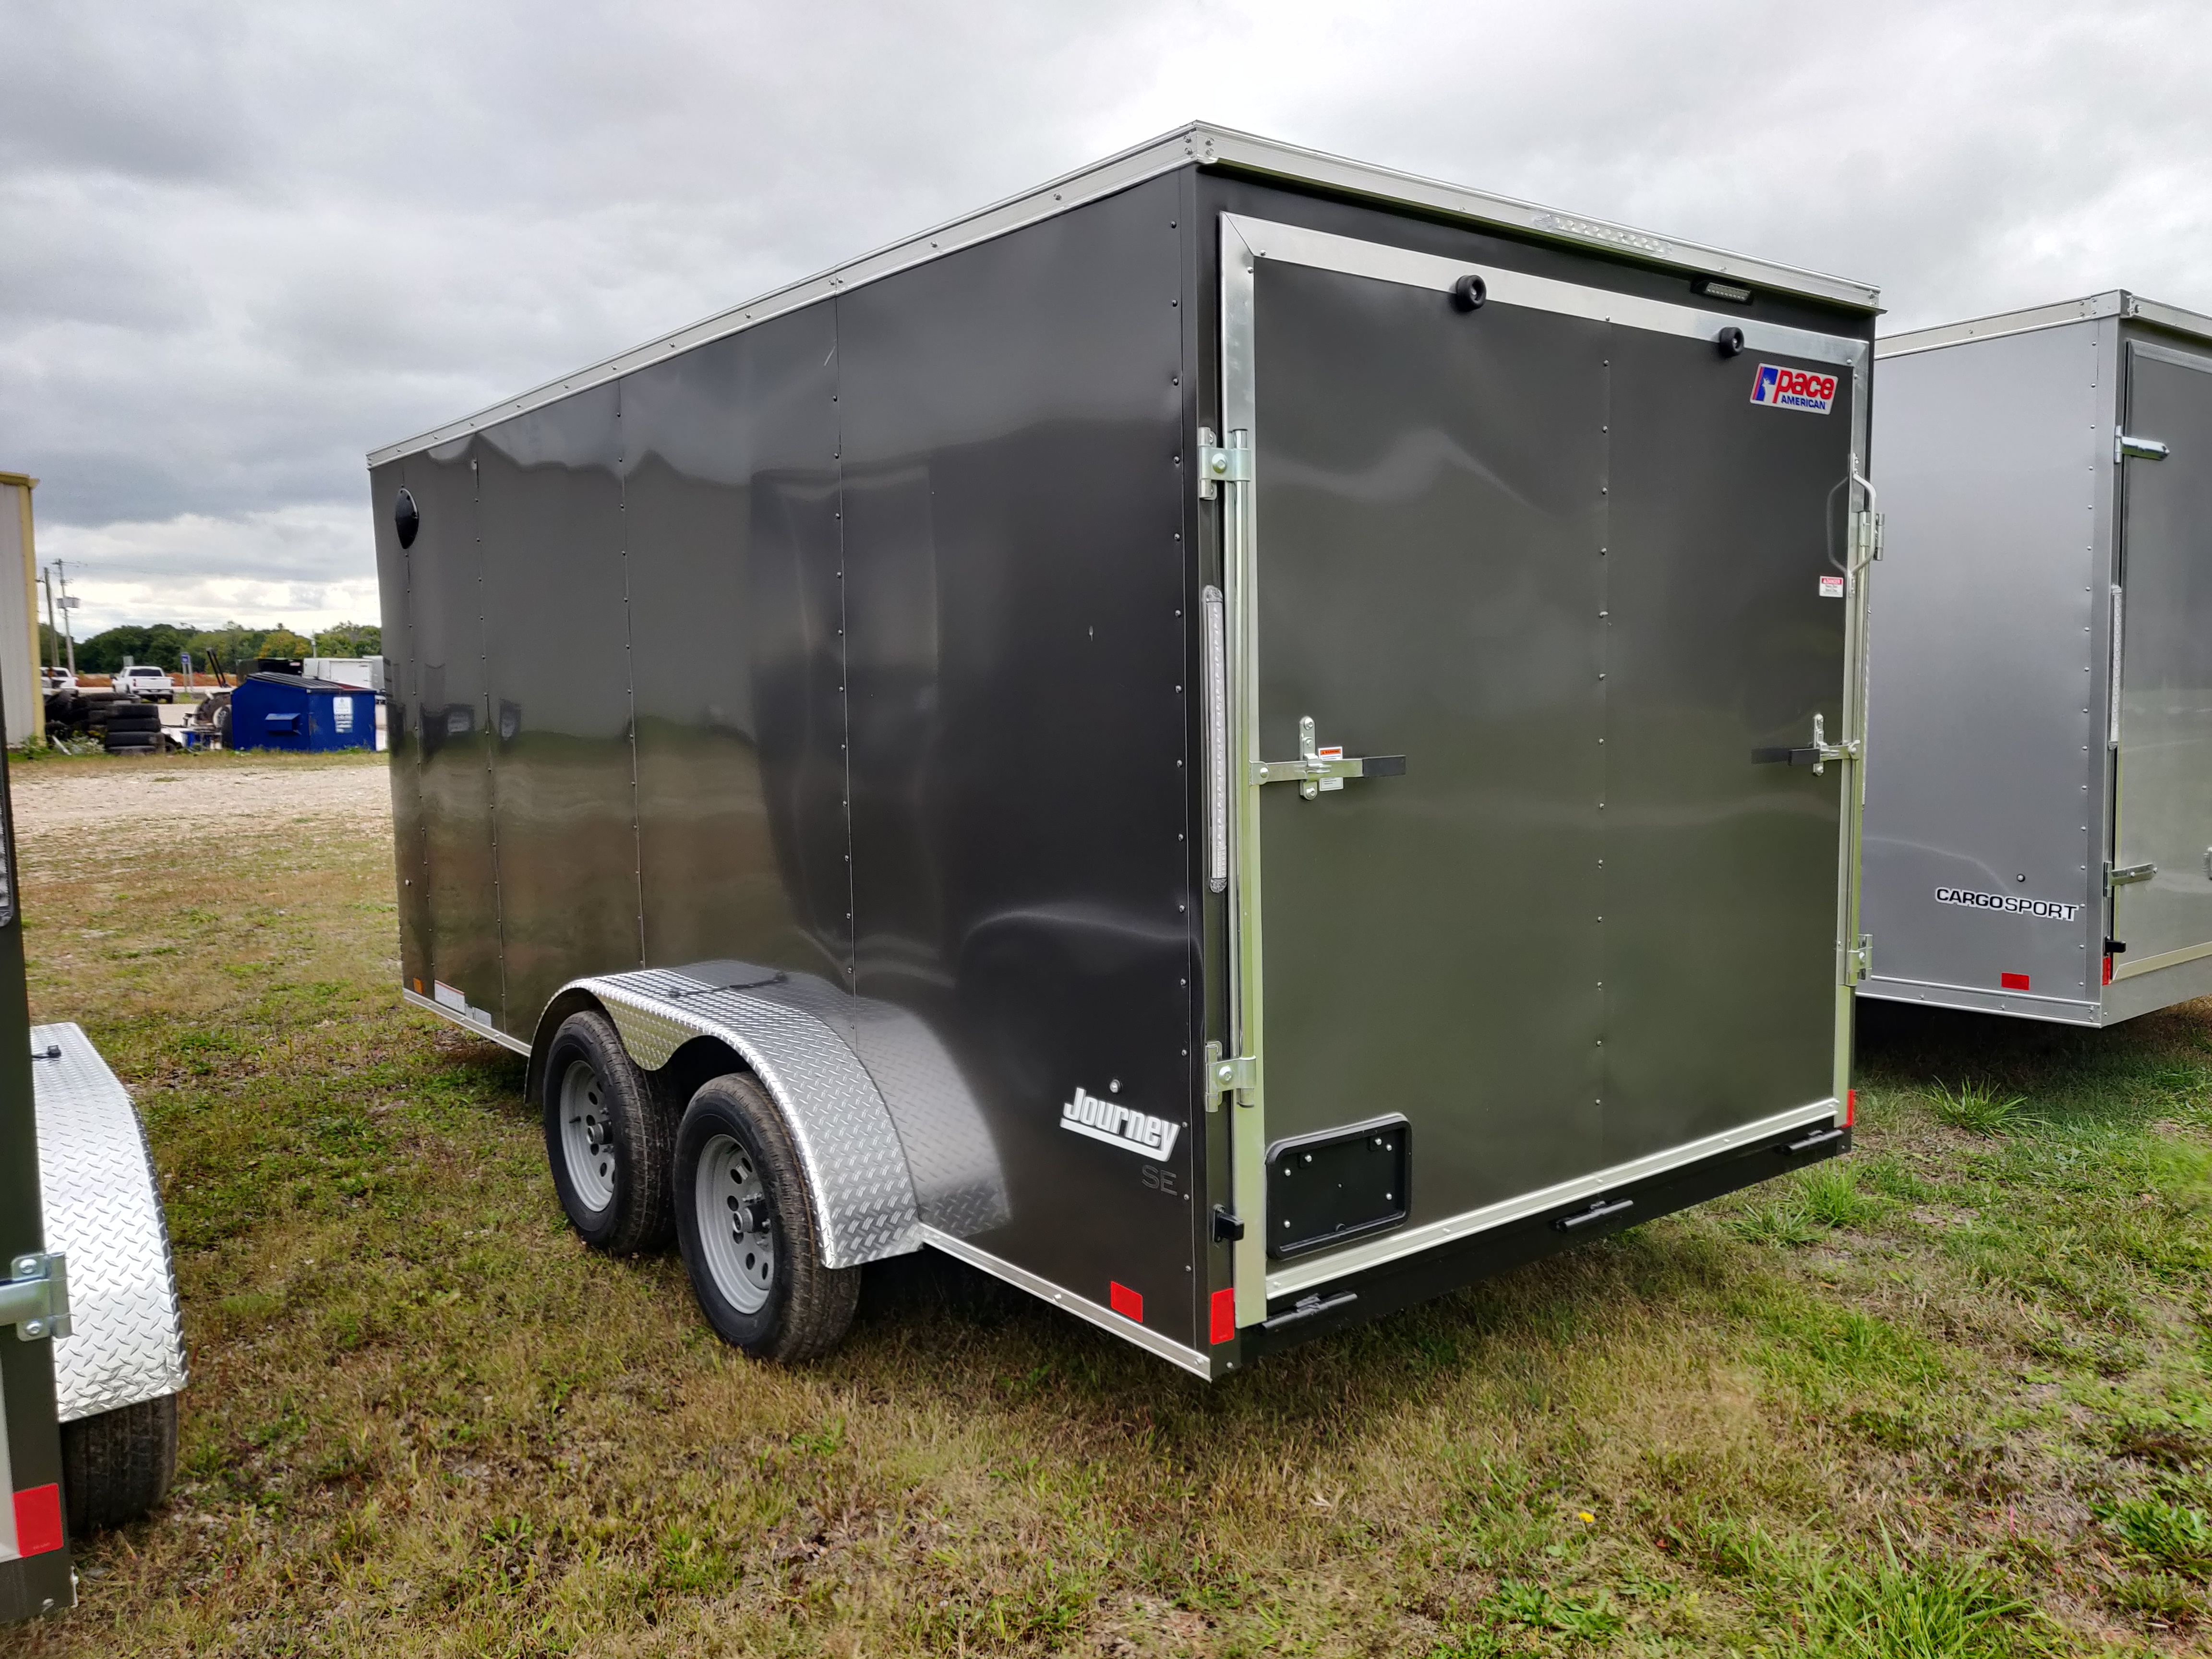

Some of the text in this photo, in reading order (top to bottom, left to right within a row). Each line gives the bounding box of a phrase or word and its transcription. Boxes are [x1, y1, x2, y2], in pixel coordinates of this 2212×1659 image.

[1772, 369, 1835, 403] pace
[1780, 395, 1826, 410] AMERICAN
[1936, 888, 2078, 920] CARGOSPORT
[1060, 1087, 1181, 1162] Journey
[1142, 1165, 1178, 1196] SE
